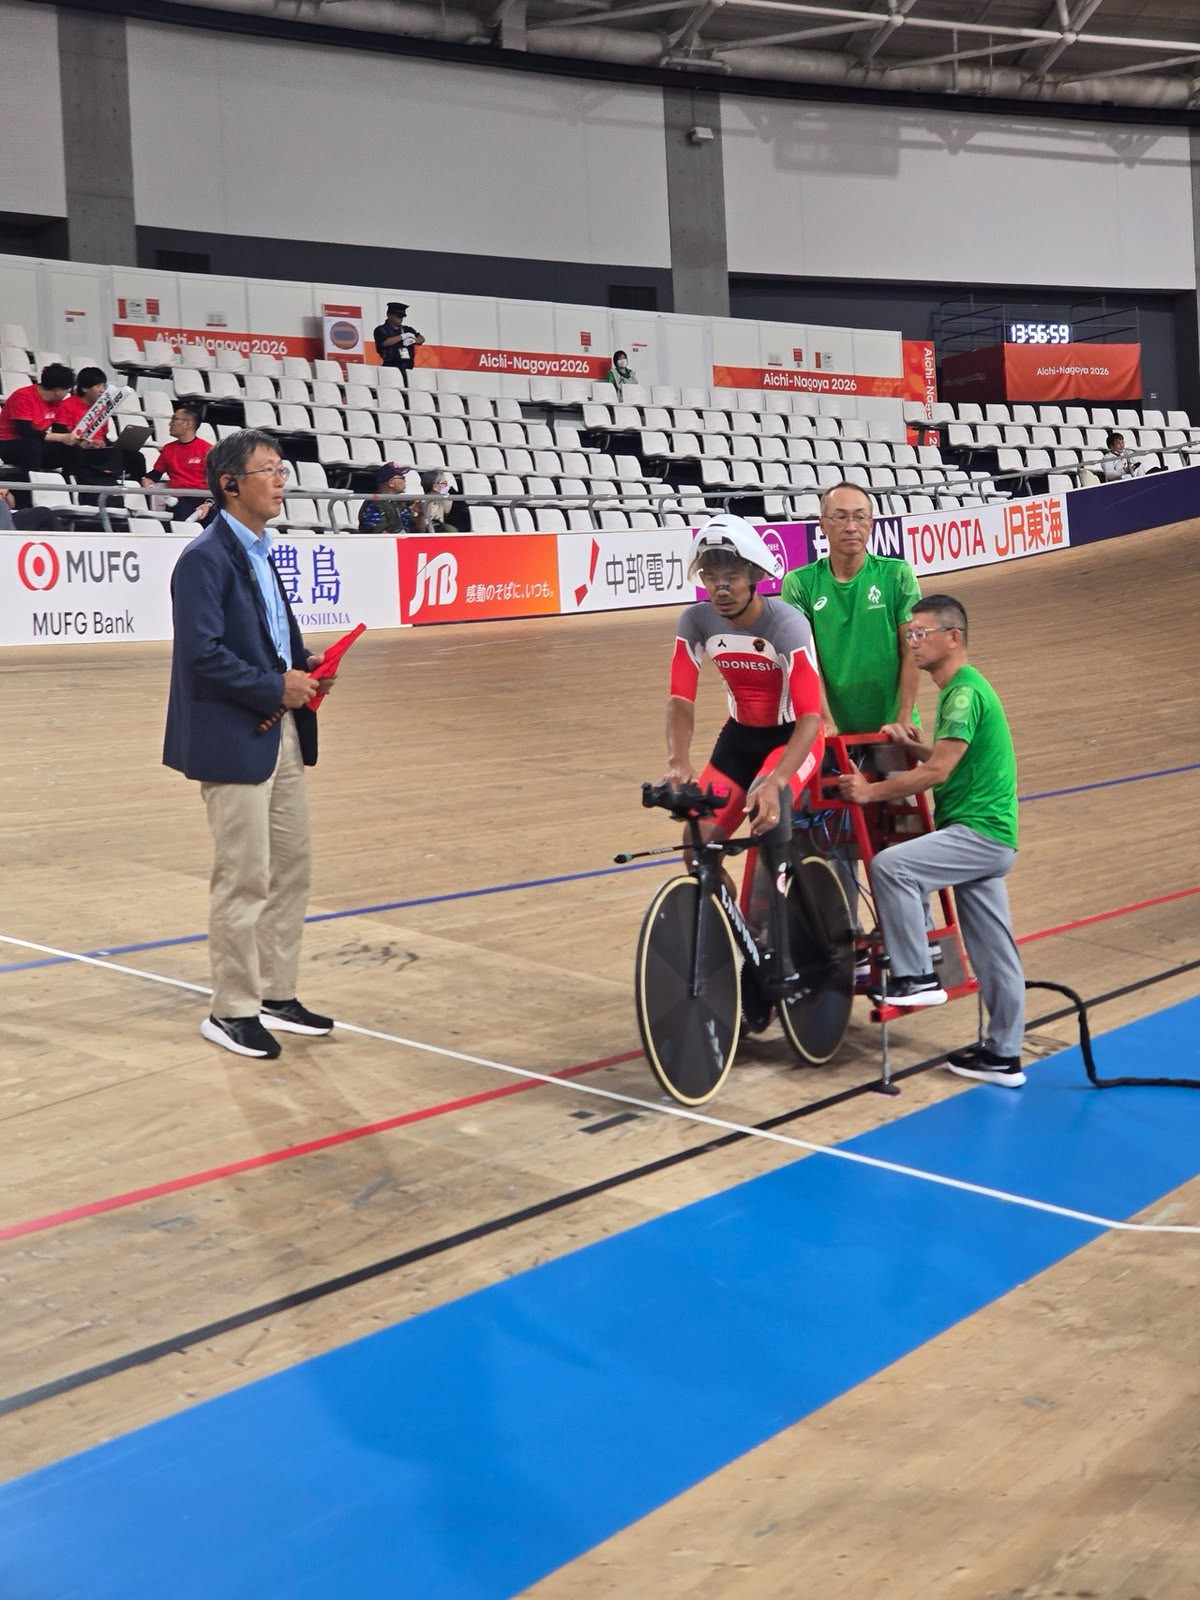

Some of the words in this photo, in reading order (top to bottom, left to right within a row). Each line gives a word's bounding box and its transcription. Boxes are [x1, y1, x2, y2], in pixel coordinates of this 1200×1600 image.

[1010, 324, 1070, 344] 13:56:59
[251, 339, 288, 355] 2026
[478, 353, 559, 375] Aichi-Nagoya
[560, 359, 590, 374] 2026
[1036, 366, 1089, 376] Aichi-Nagoya
[1090, 366, 1110, 376] 2026
[763, 372, 829, 392] Aichi-Nagoya
[831, 378, 858, 392] 2026
[994, 498, 1064, 557] JR東海
[907, 518, 986, 566] TOYOTA
[65, 550, 141, 583] MUFG
[271, 544, 341, 605] 豊島
[605, 550, 684, 596] 中部電力
[408, 551, 459, 617] JTB
[32, 611, 88, 636] MUFG
[93, 609, 135, 635] Bank
[296, 612, 351, 626] OSHIMA
[713, 659, 780, 671] NDONESIA
